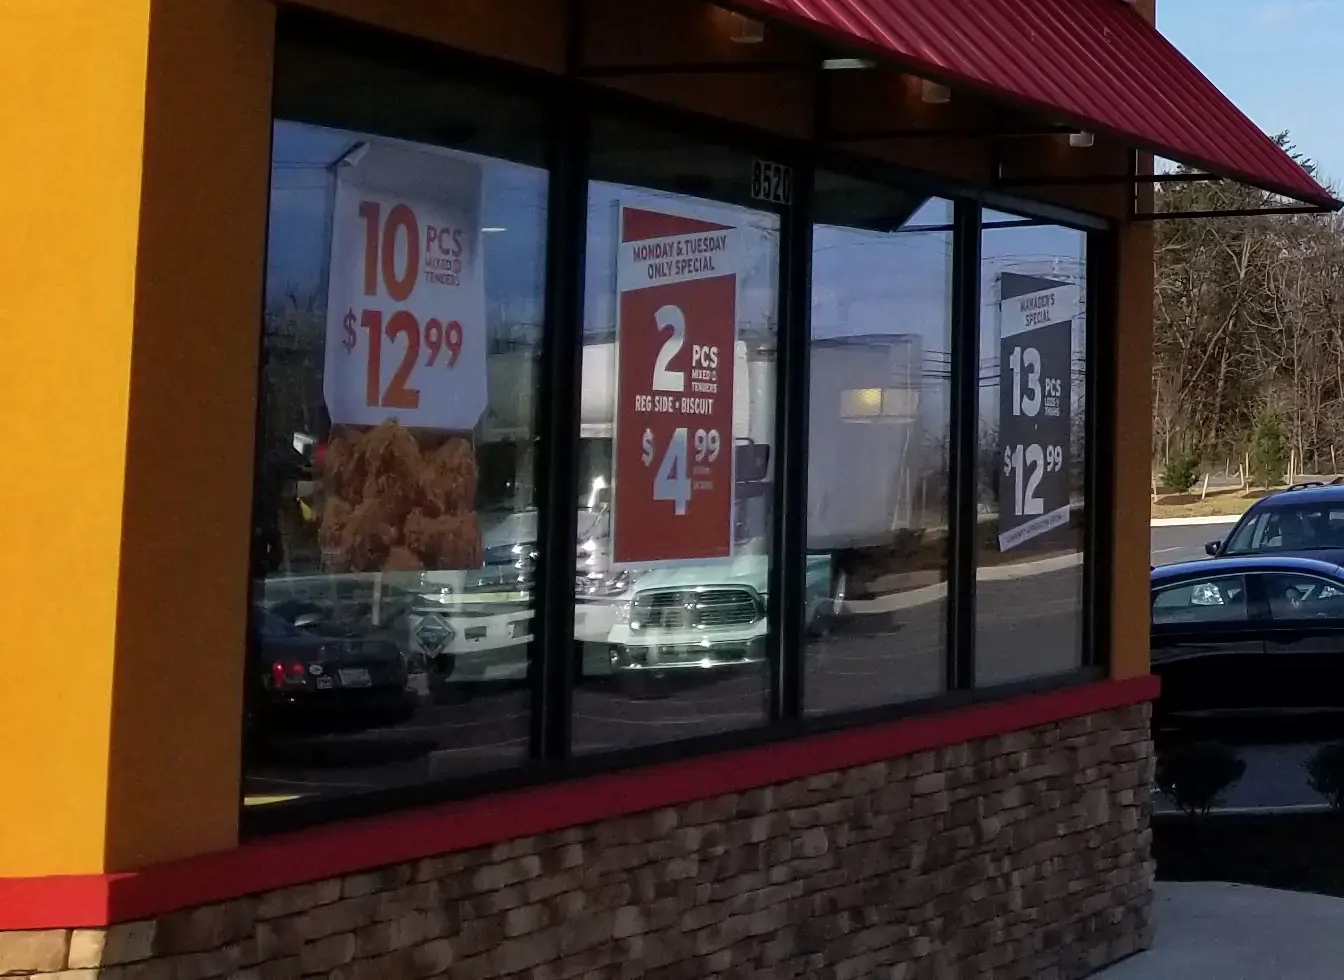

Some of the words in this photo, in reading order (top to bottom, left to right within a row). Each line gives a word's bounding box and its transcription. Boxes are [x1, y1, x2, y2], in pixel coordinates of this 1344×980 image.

[752, 160, 791, 204] 8520
[359, 200, 420, 302] 10
[425, 224, 464, 257] PCS
[632, 240, 677, 262] MONDAY
[684, 234, 727, 255] TUESDAY
[647, 260, 673, 280] ONLY
[674, 255, 715, 276] SPECIAL
[1025, 309, 1051, 327] SPECIAL
[652, 304, 685, 392] 2
[692, 344, 718, 369] PCS
[1009, 346, 1042, 417] 13
[1045, 378, 1061, 397] PCS
[635, 394, 652, 412] REG
[654, 395, 674, 413] SIDE
[681, 397, 714, 415] BISCUIT
